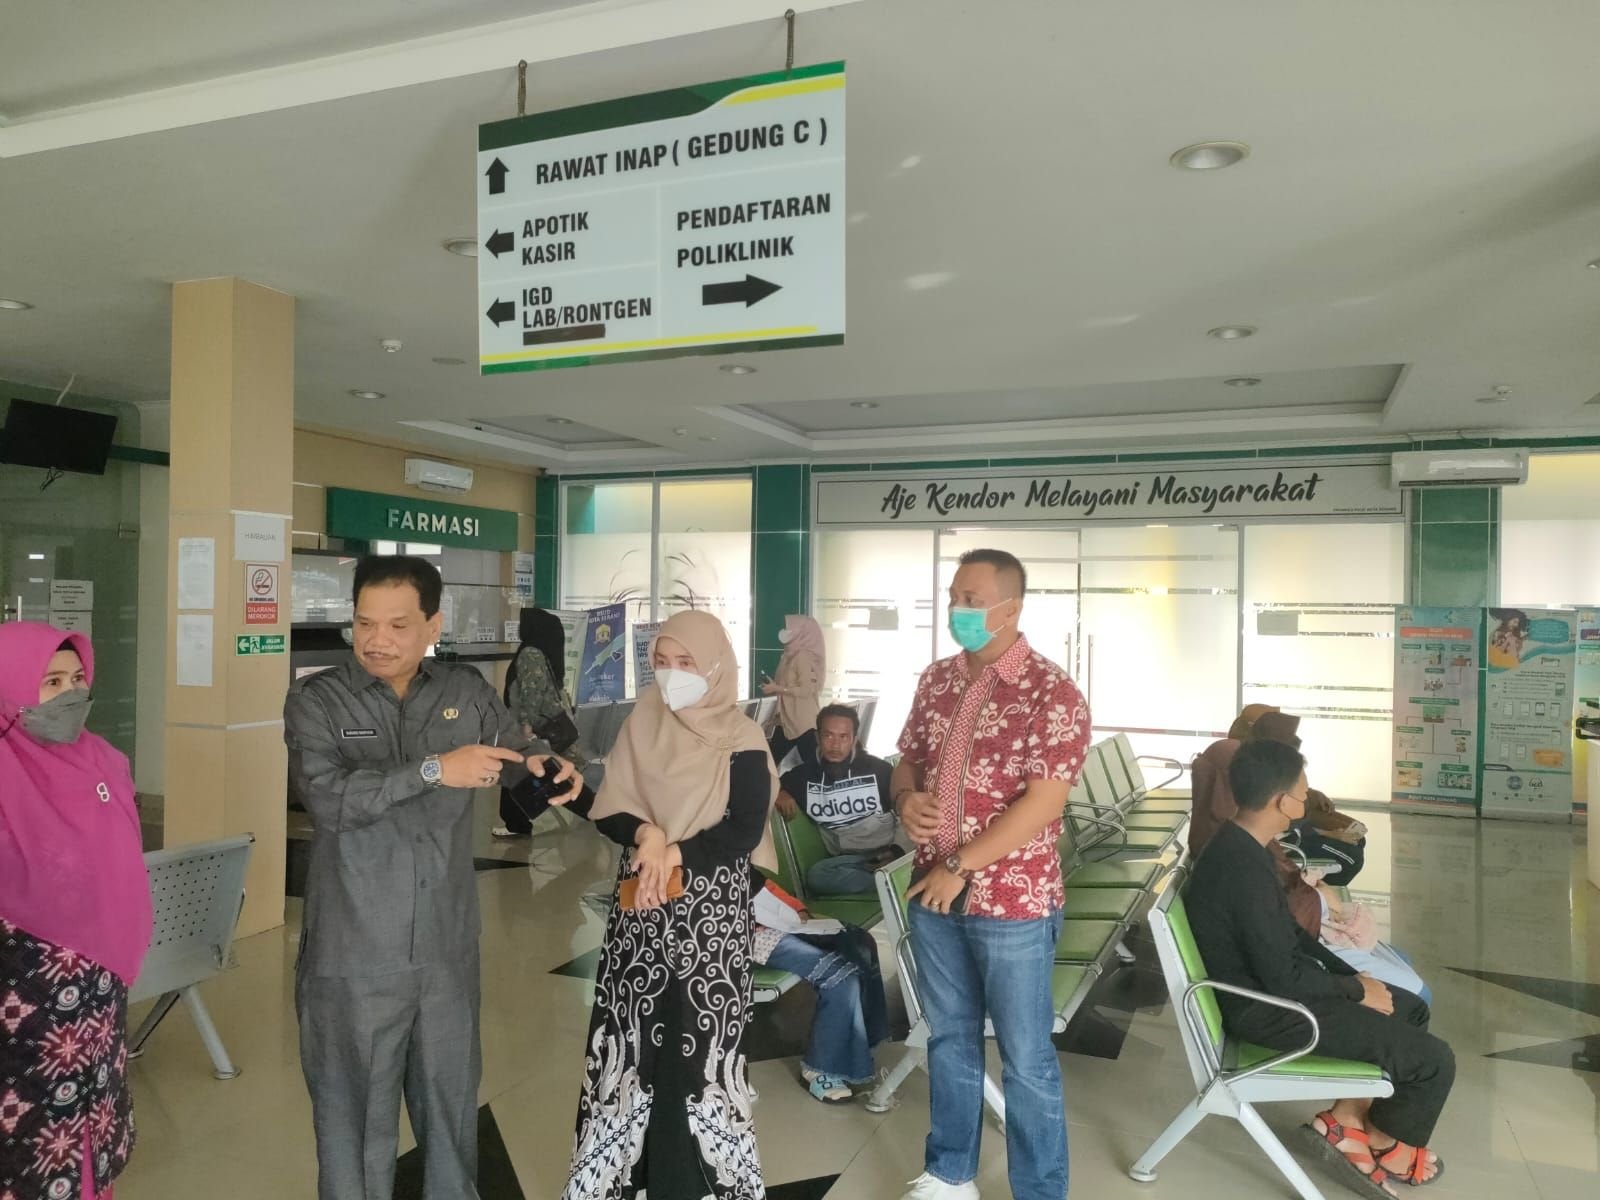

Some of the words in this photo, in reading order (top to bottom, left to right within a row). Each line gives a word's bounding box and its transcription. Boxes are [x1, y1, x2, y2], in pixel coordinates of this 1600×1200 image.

[536, 153, 608, 185] RAWAT
[615, 144, 668, 173] INAP
[688, 124, 784, 159] GEDUNG
[793, 120, 810, 145] C
[522, 212, 590, 239] APOTIK
[676, 193, 831, 231] PENDAFTARAN
[522, 241, 576, 266] KASIR
[676, 236, 795, 268] POLIKLINIK
[522, 286, 553, 307] IGD
[522, 297, 652, 329] LAB/RONTGEN
[881, 483, 918, 519] Aje
[925, 482, 1015, 515] Kendor
[1025, 479, 1141, 515] Melayani
[1147, 473, 1325, 513] Masyarakat
[388, 508, 479, 537] FARMASI
[810, 795, 878, 817] adidas
